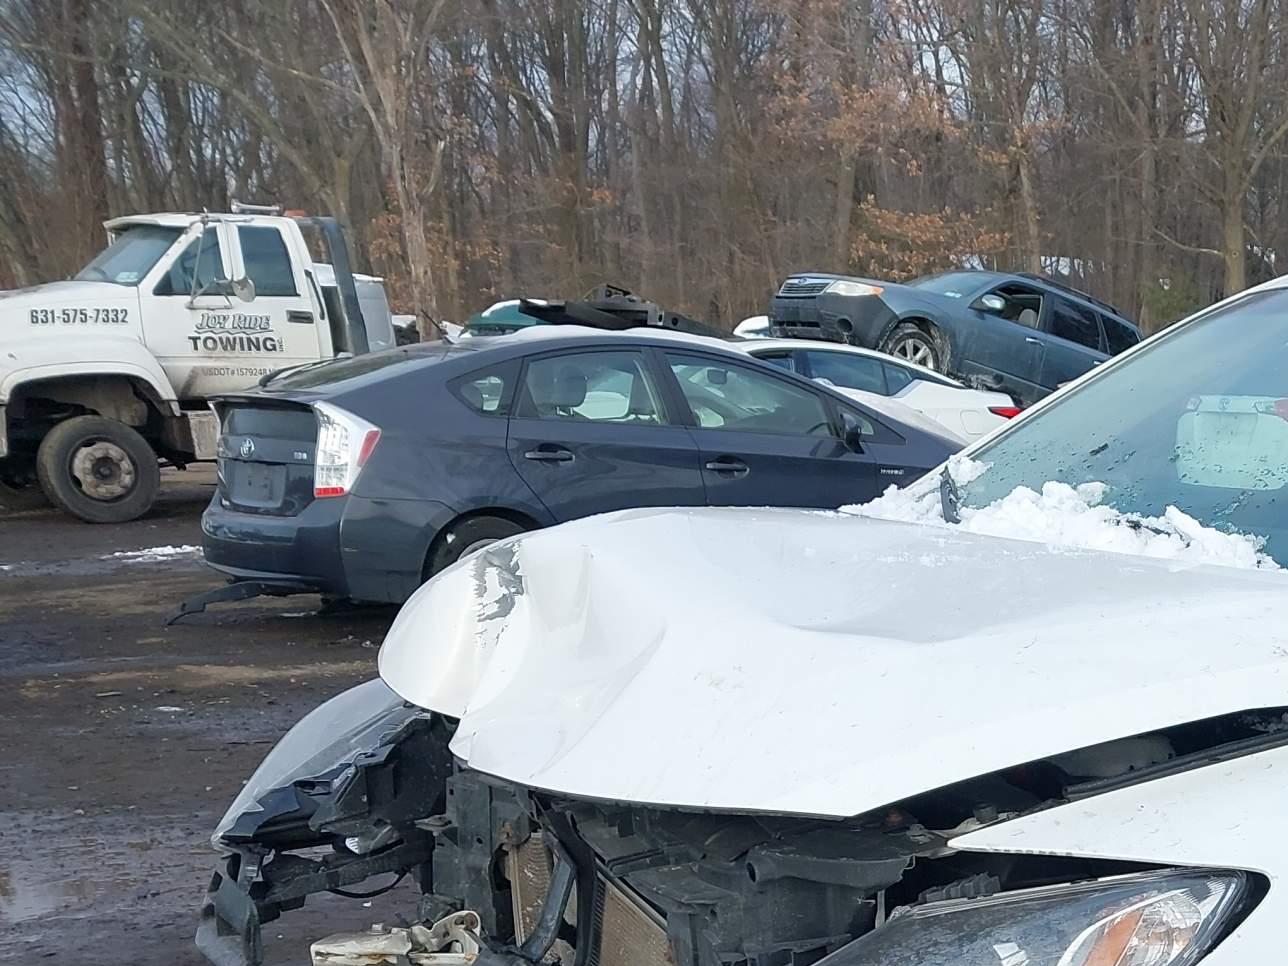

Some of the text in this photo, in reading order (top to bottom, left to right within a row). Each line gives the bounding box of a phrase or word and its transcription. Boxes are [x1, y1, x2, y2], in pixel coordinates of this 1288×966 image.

[30, 308, 129, 324] 631-575-7332
[195, 312, 271, 330] JOY RIDE
[187, 335, 277, 352] TOWING
